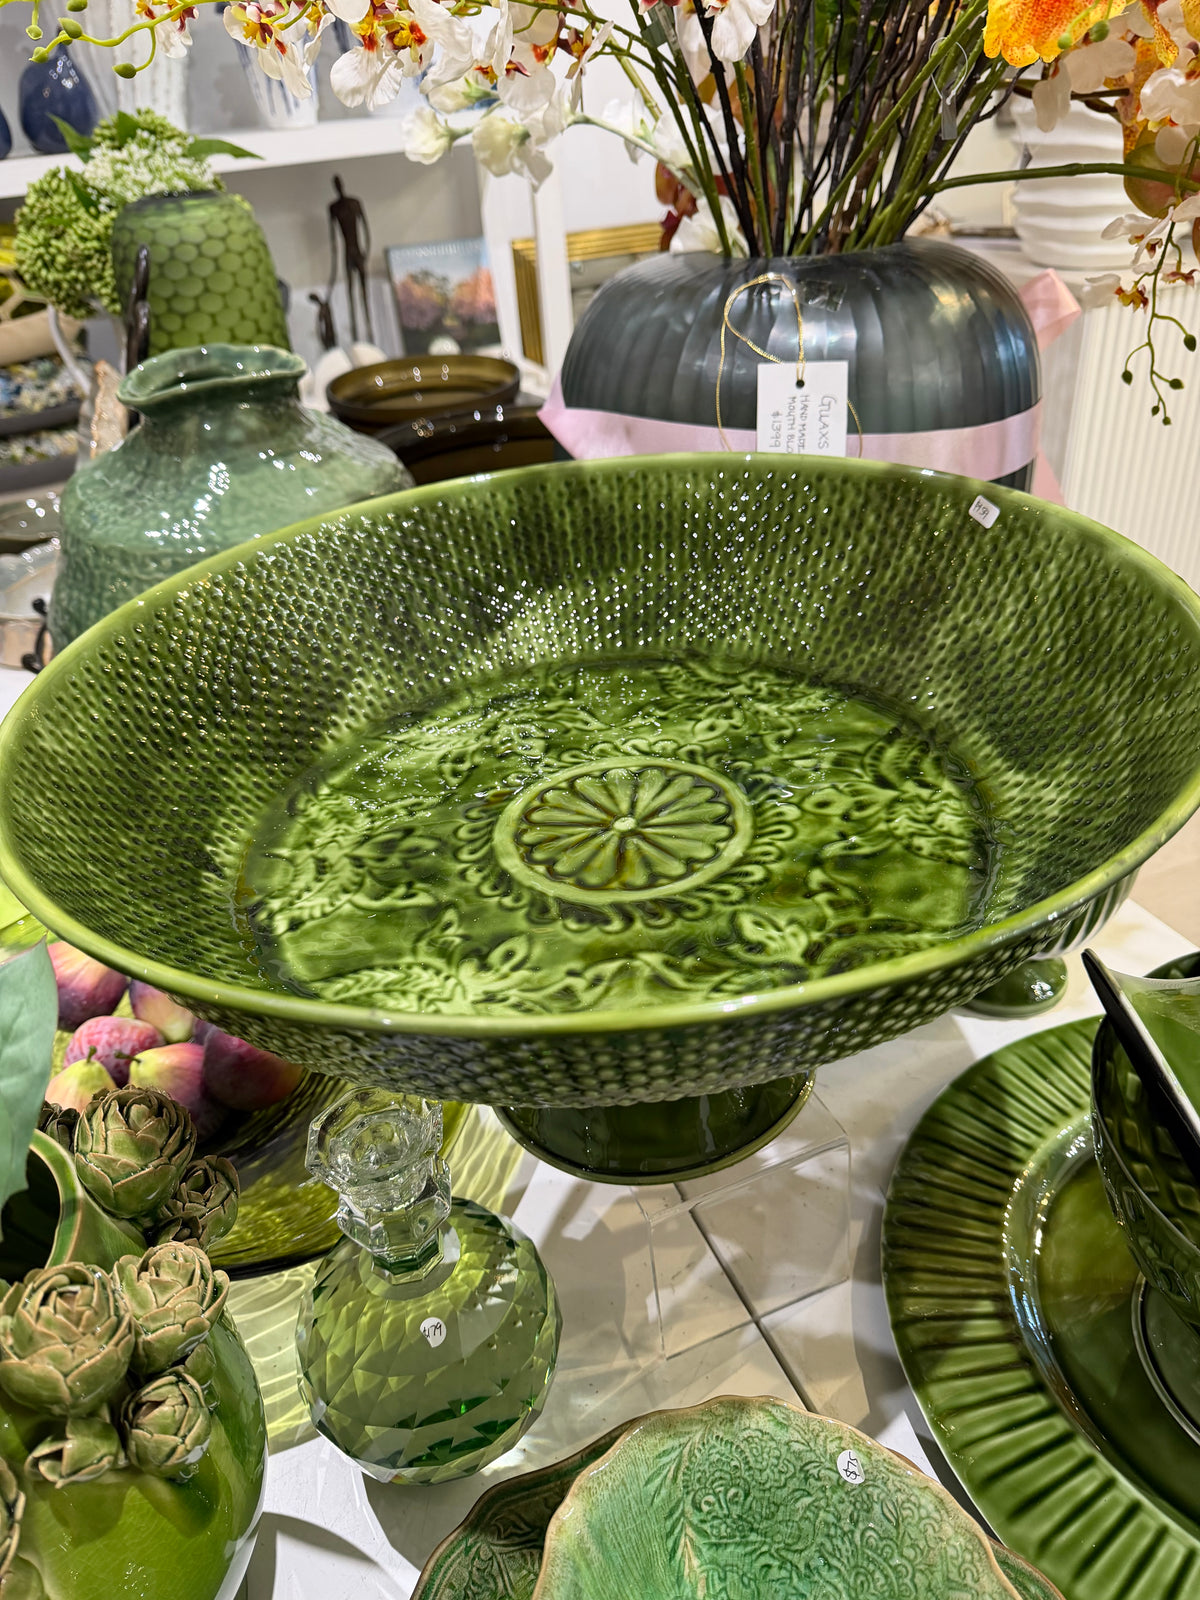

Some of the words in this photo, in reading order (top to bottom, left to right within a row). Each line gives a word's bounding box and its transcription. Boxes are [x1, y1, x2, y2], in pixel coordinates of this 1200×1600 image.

[786, 396, 797, 431] MOUTH
[799, 394, 810, 421] HAND
[818, 395, 837, 450] GUAXS
[769, 410, 783, 448] $1399
[842, 1451, 861, 1480] $75
